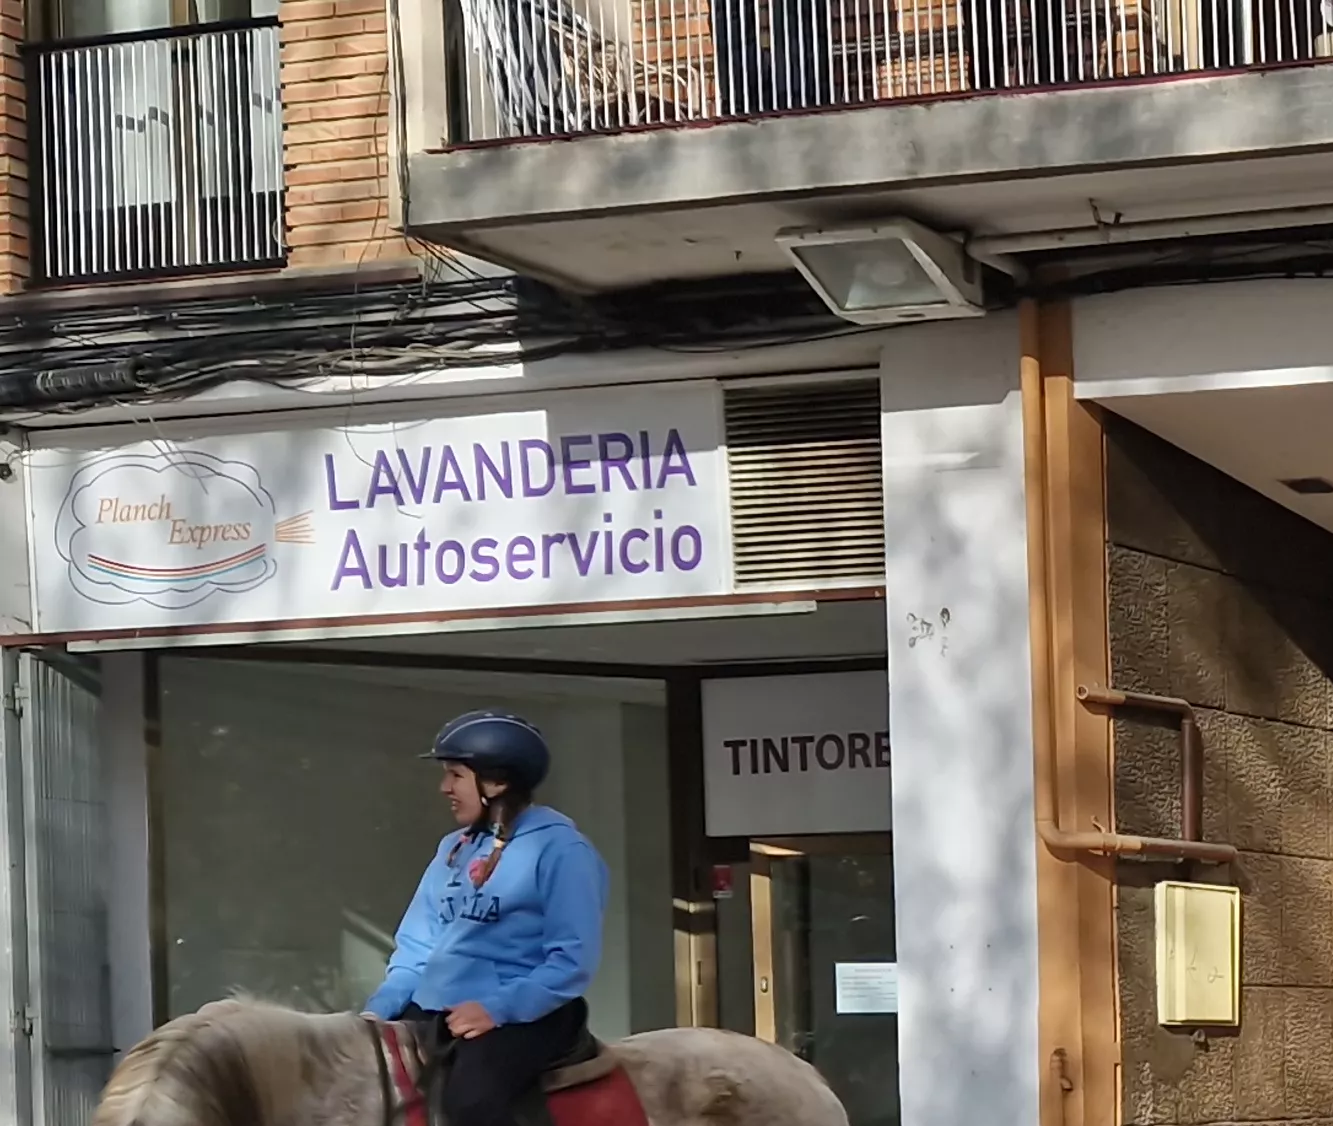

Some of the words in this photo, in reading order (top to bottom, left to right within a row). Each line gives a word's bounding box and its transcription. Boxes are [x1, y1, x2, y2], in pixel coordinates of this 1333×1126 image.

[324, 429, 698, 511] LAVANDERIA
[96, 493, 173, 526] Planch
[168, 517, 254, 550] Express
[330, 509, 704, 592] Autoservicio
